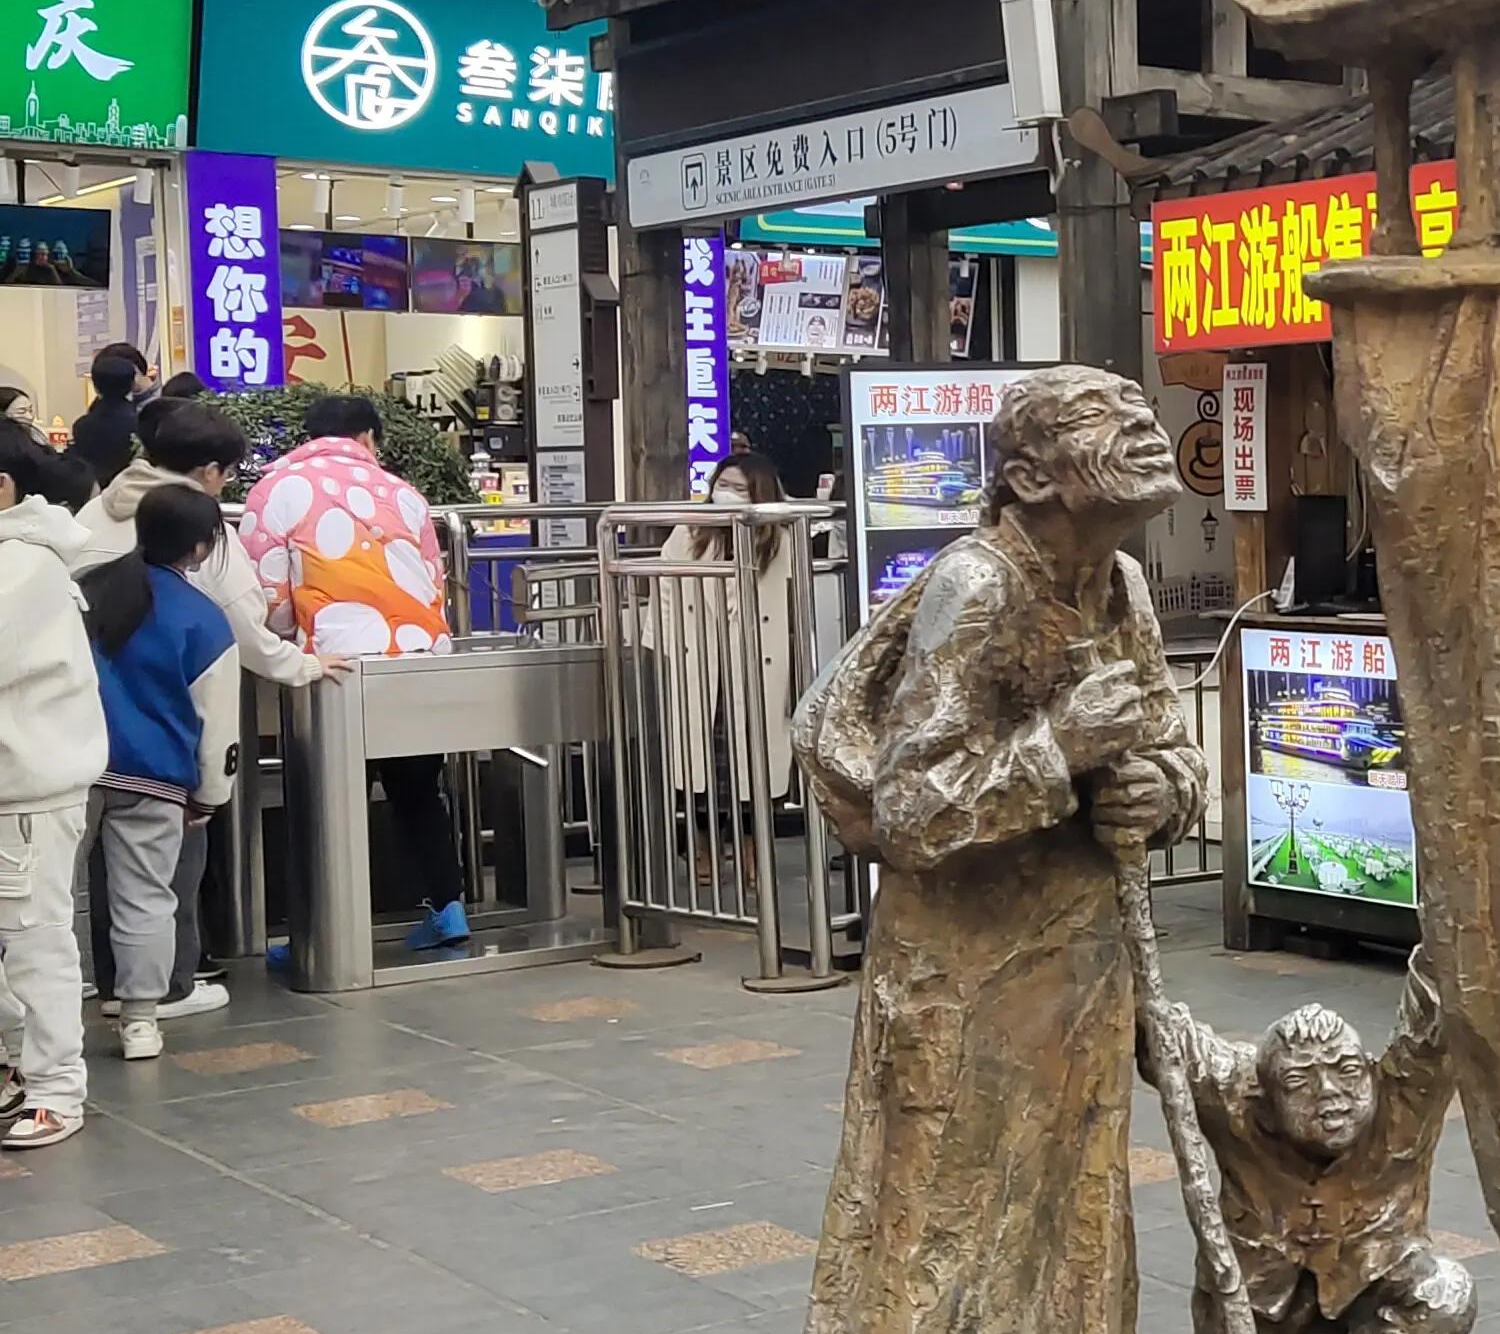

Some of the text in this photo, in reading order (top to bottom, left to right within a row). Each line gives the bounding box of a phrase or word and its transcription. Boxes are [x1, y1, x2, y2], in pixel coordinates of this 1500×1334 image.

[457, 38, 614, 113] 叁柒
[456, 102, 613, 137] SANQIK
[714, 106, 958, 188] 景区免费入口(5号门)
[203, 203, 270, 384] 想你的
[869, 383, 1007, 416] 两江游船
[1233, 387, 1256, 501] 现场出票
[1269, 637, 1386, 675] 两江游船
